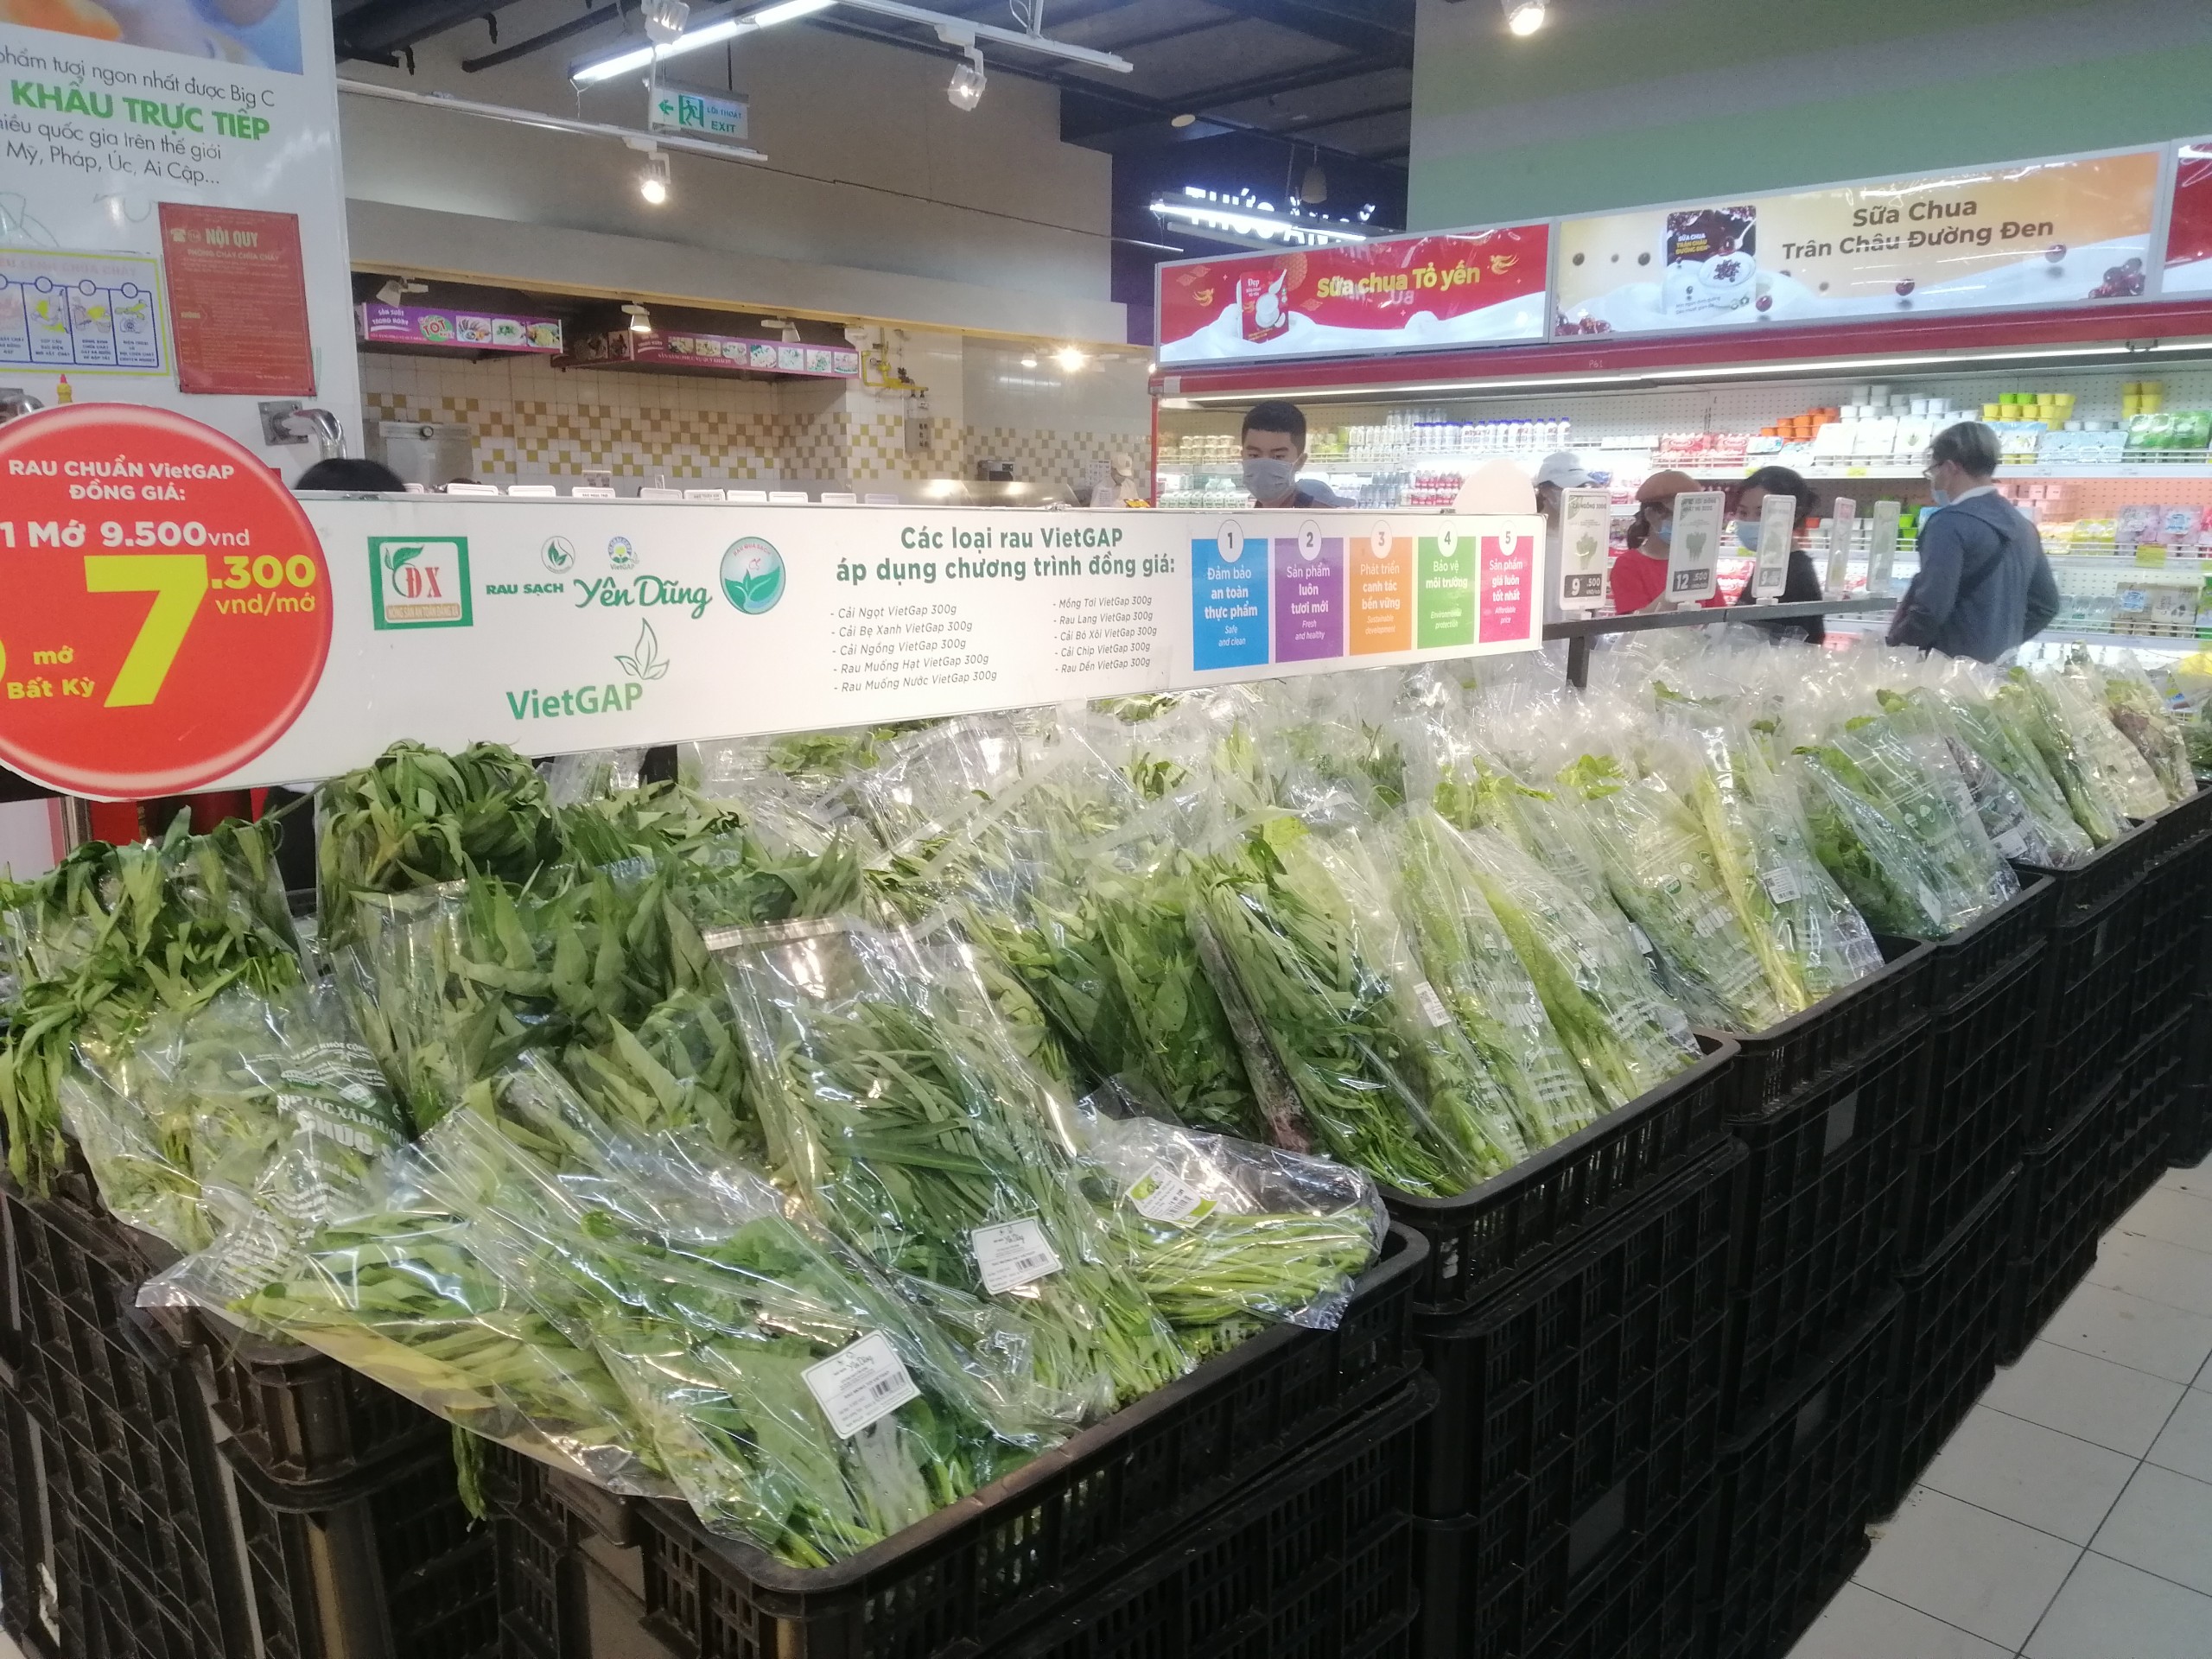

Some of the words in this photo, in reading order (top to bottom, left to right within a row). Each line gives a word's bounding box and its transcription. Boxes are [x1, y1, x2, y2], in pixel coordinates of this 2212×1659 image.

[54, 56, 85, 75] tươi
[92, 67, 137, 86] ngon
[143, 70, 179, 92] nhất
[185, 77, 226, 100] được
[231, 85, 256, 109] Big
[262, 90, 275, 106] C
[11, 75, 114, 118] KHẨU
[123, 99, 203, 135] TRỰC
[212, 105, 270, 140] TIẾP
[711, 121, 736, 133] EXIT
[38, 122, 83, 142] quốc
[90, 129, 118, 148] gia
[124, 134, 154, 150] trên
[161, 135, 185, 155] thế
[191, 143, 220, 162] giới
[7, 140, 43, 165] Mỹ,
[50, 146, 101, 173] Pháp,
[144, 160, 161, 176] Ai
[1853, 206, 1899, 226] Sữa
[1909, 200, 1977, 221] Chua
[206, 226, 230, 248] NỘI
[233, 231, 257, 248] QUY
[1783, 240, 1832, 259] Trân
[1840, 233, 1899, 254] Châu
[1908, 226, 1992, 247] Đường
[2000, 221, 2053, 239] Đen
[1317, 276, 1353, 297] Sữa
[1358, 272, 1408, 294] chua
[1412, 262, 1437, 289] Tổ
[1440, 259, 1480, 291] yến
[9, 460, 57, 476] RAU
[64, 454, 144, 479] CHUẨN
[152, 462, 234, 479] VietGAP
[69, 479, 136, 500] ĐỒNG
[142, 482, 185, 501] GIÁ:
[0, 522, 16, 548] 1
[901, 525, 944, 550] Các
[952, 526, 992, 554] loại
[1001, 531, 1033, 548] rau
[1040, 527, 1123, 548] VietGAP
[1227, 532, 1233, 549] 1
[1306, 532, 1313, 548] 2
[1378, 531, 1385, 546] 3
[1444, 531, 1451, 545] 4
[1505, 531, 1510, 544] 5
[836, 558, 867, 586] áp
[876, 558, 937, 586] dụng
[945, 556, 1027, 581] chương
[1033, 555, 1082, 577] trình
[1089, 550, 1136, 578] đồng
[1142, 552, 1175, 577] giá:
[1287, 563, 1304, 578] Sản
[1306, 563, 1330, 579] phẩm
[1361, 563, 1379, 575] Phát
[1382, 560, 1400, 574] triển
[1433, 560, 1448, 572] Bảo
[1450, 562, 1459, 574] vệ
[1490, 559, 1502, 571] Sản
[1503, 557, 1522, 571] phẩm
[1207, 565, 1230, 580] Đảm
[1233, 564, 1251, 579] bảo
[1363, 582, 1382, 593] canh
[1384, 581, 1397, 591] tác
[1426, 577, 1440, 588] môi
[1442, 576, 1468, 589] trường
[1492, 575, 1503, 587] giá
[1504, 574, 1519, 586] luôn
[1572, 578, 1580, 596] 9
[1676, 574, 1689, 589] 12
[1211, 589, 1224, 600] an
[1226, 585, 1248, 599] toàn
[1299, 583, 1319, 596] luôn
[1493, 589, 1503, 601] tốt
[1504, 588, 1520, 601] nhất
[486, 584, 518, 595] RAU
[524, 582, 564, 596] SẠCH
[574, 576, 635, 608] Yên
[634, 575, 713, 620] Dũng
[1099, 596, 1130, 607] VietGap
[1132, 595, 1152, 606] 300g
[1380, 596, 1400, 610] vững
[838, 607, 855, 619] Cải
[859, 607, 885, 619] Ngọt
[888, 606, 928, 617] VietGap
[931, 604, 957, 615] 300g
[1205, 606, 1227, 622] thực
[1230, 601, 1257, 620] phẩm
[1291, 601, 1310, 614] tươi
[1312, 601, 1328, 613] mới
[1059, 615, 1075, 625] Rau
[1077, 615, 1097, 625] Lang
[1100, 613, 1130, 622] VietGap
[1133, 612, 1153, 621] 300g
[1302, 620, 1317, 628] Fresh
[1367, 614, 1394, 623] Sustainable
[1435, 620, 1459, 630] protection
[840, 625, 855, 637] Cải
[860, 626, 873, 638] Bẹ
[876, 624, 901, 635] Xanh
[906, 622, 944, 634] VietGap
[948, 620, 973, 632] 300g
[1060, 631, 1073, 641] Cải
[1104, 628, 1135, 638] VietGap
[1137, 626, 1157, 636] 300g
[1225, 625, 1237, 634] Safe
[1306, 631, 1325, 640] healthy
[1365, 625, 1395, 635] development
[841, 643, 857, 656] Cải
[899, 640, 938, 652] VietGap
[941, 639, 966, 649] 300g
[1061, 646, 1074, 657] Cải
[1077, 646, 1095, 656] Chip
[1097, 644, 1128, 654] VietGap
[1130, 642, 1151, 652] 300g
[1218, 639, 1230, 647] and
[1230, 638, 1246, 646] clean
[842, 664, 861, 674] Rau
[903, 659, 919, 671] Hạt
[924, 657, 961, 668] VietGap
[964, 654, 989, 665] 300g
[1061, 664, 1077, 673] Rau
[1097, 659, 1128, 670] VietGap
[1130, 658, 1151, 667] 300g
[7, 676, 53, 700] Bất
[842, 683, 861, 693] Rau
[932, 674, 969, 684] VietGap
[973, 671, 997, 681] 300g
[506, 683, 643, 721] VietGAP
